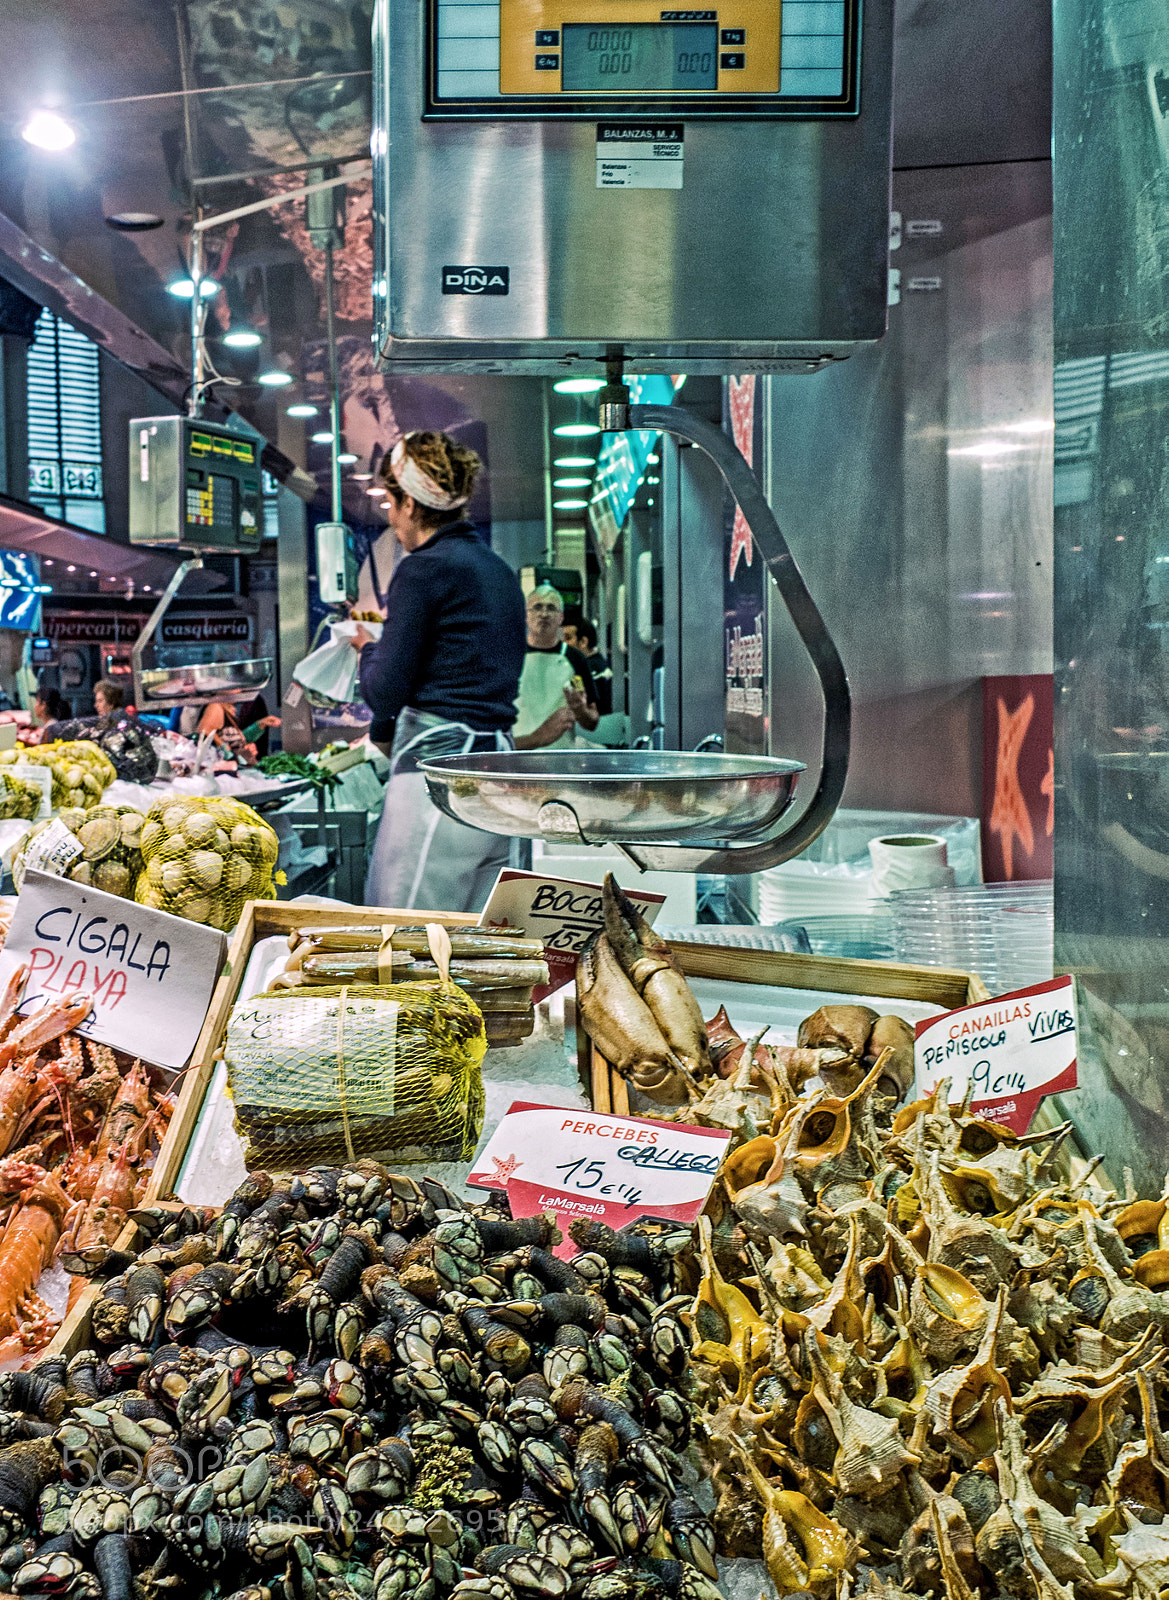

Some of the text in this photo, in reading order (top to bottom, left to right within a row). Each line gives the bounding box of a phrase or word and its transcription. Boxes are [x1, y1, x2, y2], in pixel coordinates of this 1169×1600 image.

[587, 30, 633, 50] 0.000
[604, 130, 655, 139] BALANZAS,
[445, 274, 506, 286] DINA
[29, 947, 127, 1011] PLAYA
[949, 1003, 1031, 1040] CANAILLAS
[560, 1119, 660, 1145] PERCEBES
[538, 1194, 606, 1215] LaMarsalà
